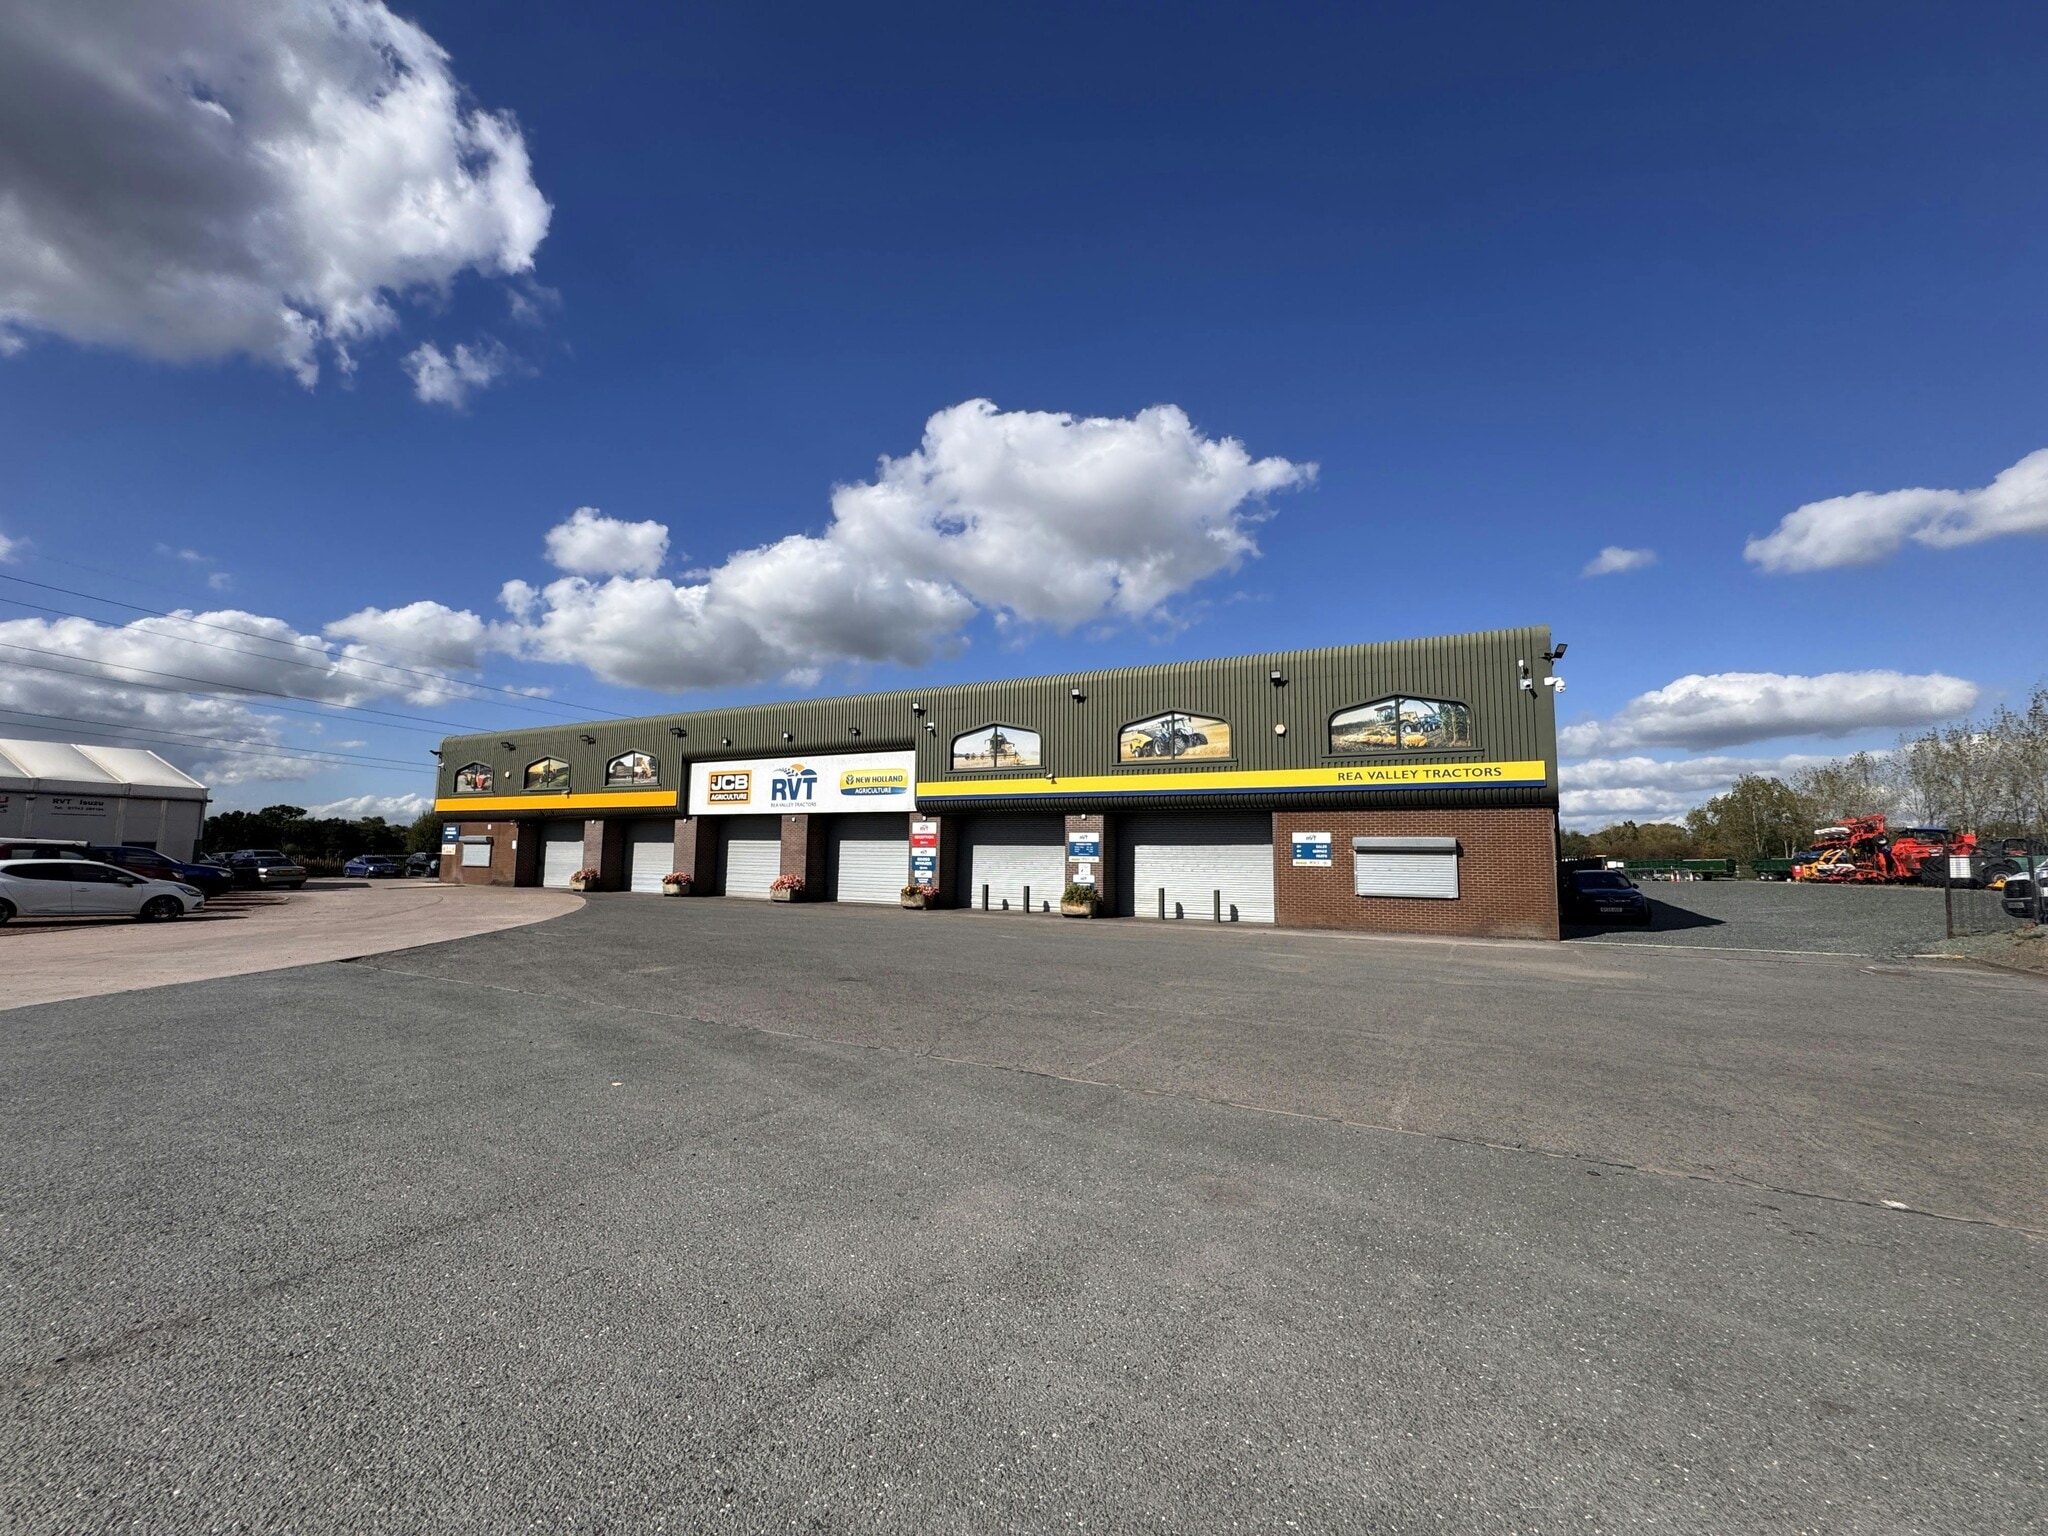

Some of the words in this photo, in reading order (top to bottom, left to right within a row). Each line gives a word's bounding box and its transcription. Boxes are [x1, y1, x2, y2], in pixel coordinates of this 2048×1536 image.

[855, 776, 871, 784] NEW
[872, 775, 903, 783] HOLLAND
[1337, 771, 1363, 781] REA
[1367, 769, 1418, 780] VALLEY
[1423, 767, 1502, 779] TRACTORS
[711, 774, 749, 791] JCB
[771, 777, 818, 801] RVT
[854, 786, 892, 795] AGRICULTURE
[711, 793, 748, 801] AGRICULTURE
